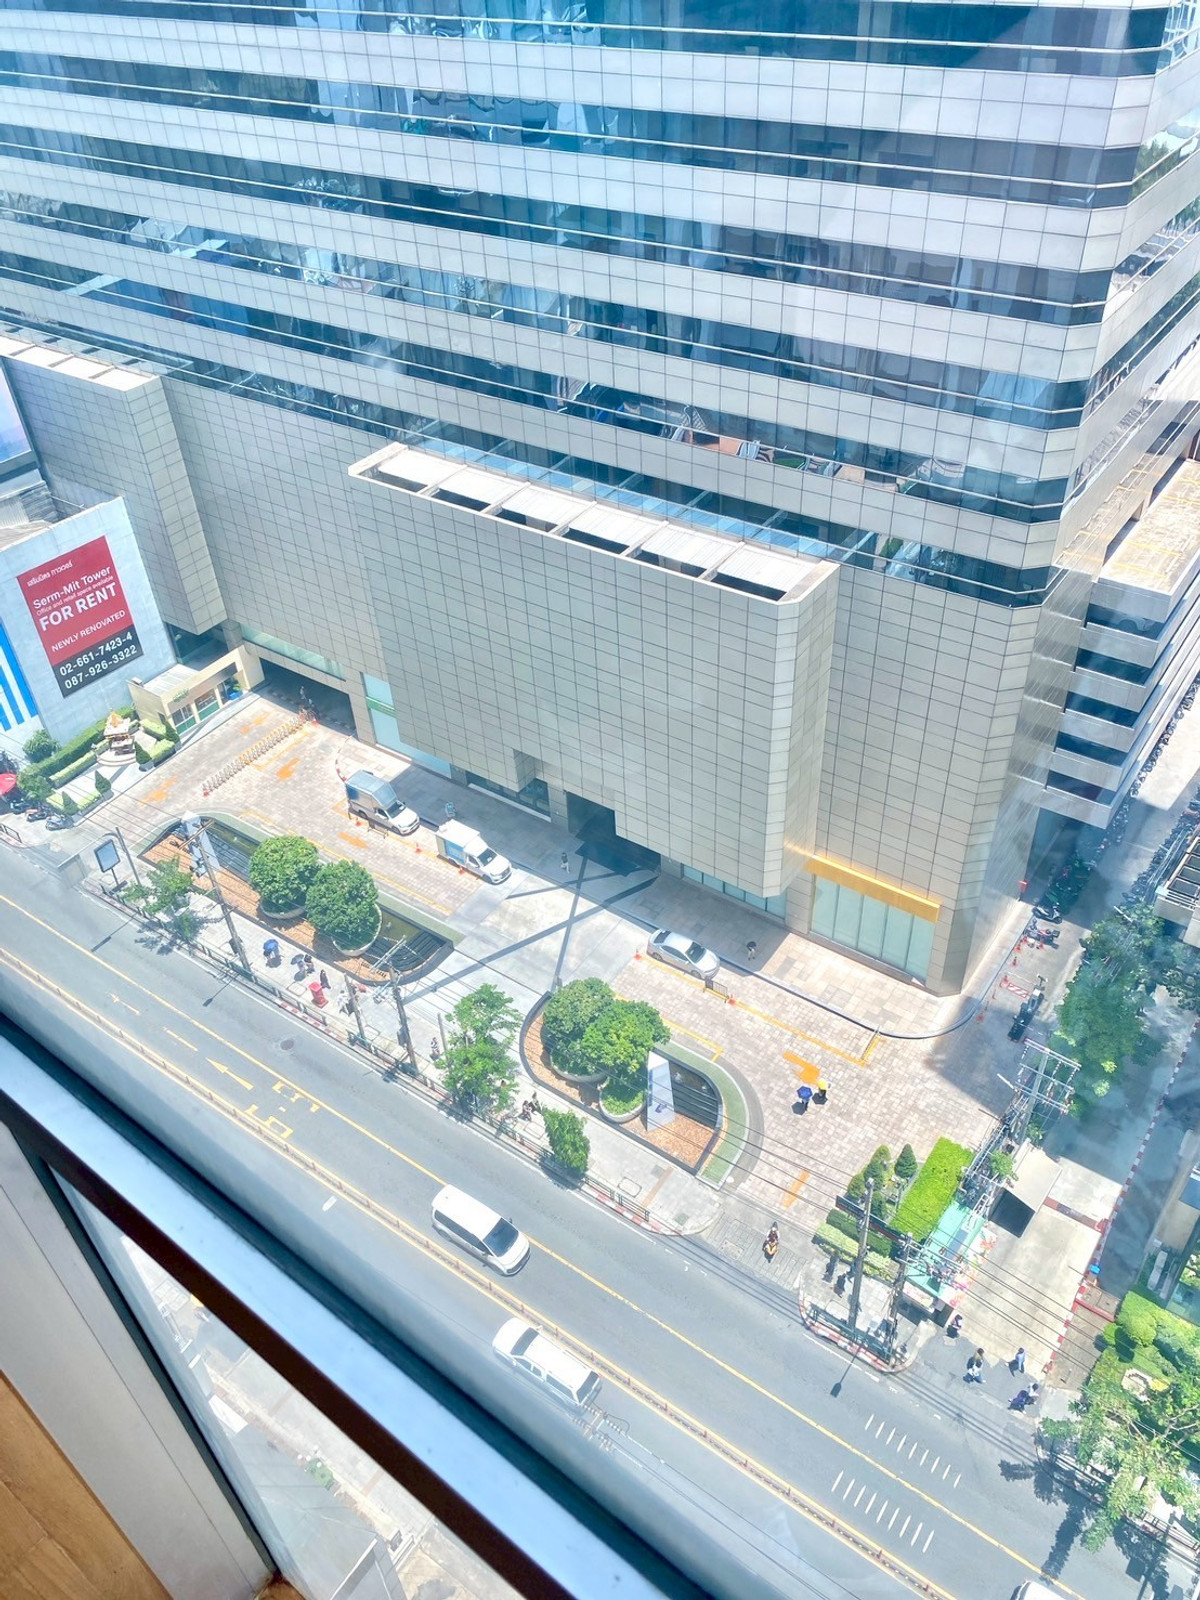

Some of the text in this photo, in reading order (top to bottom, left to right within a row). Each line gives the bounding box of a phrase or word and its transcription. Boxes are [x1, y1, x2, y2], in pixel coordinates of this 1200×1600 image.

[33, 566, 111, 609] Serm-Mit Tower
[36, 575, 114, 616] Office and retail space available
[39, 582, 118, 632] FOR RENT
[51, 609, 126, 653] NEWLY RENOVATED
[59, 631, 133, 676] 02-661-7423-4
[64, 644, 138, 689] 087-926-3322
